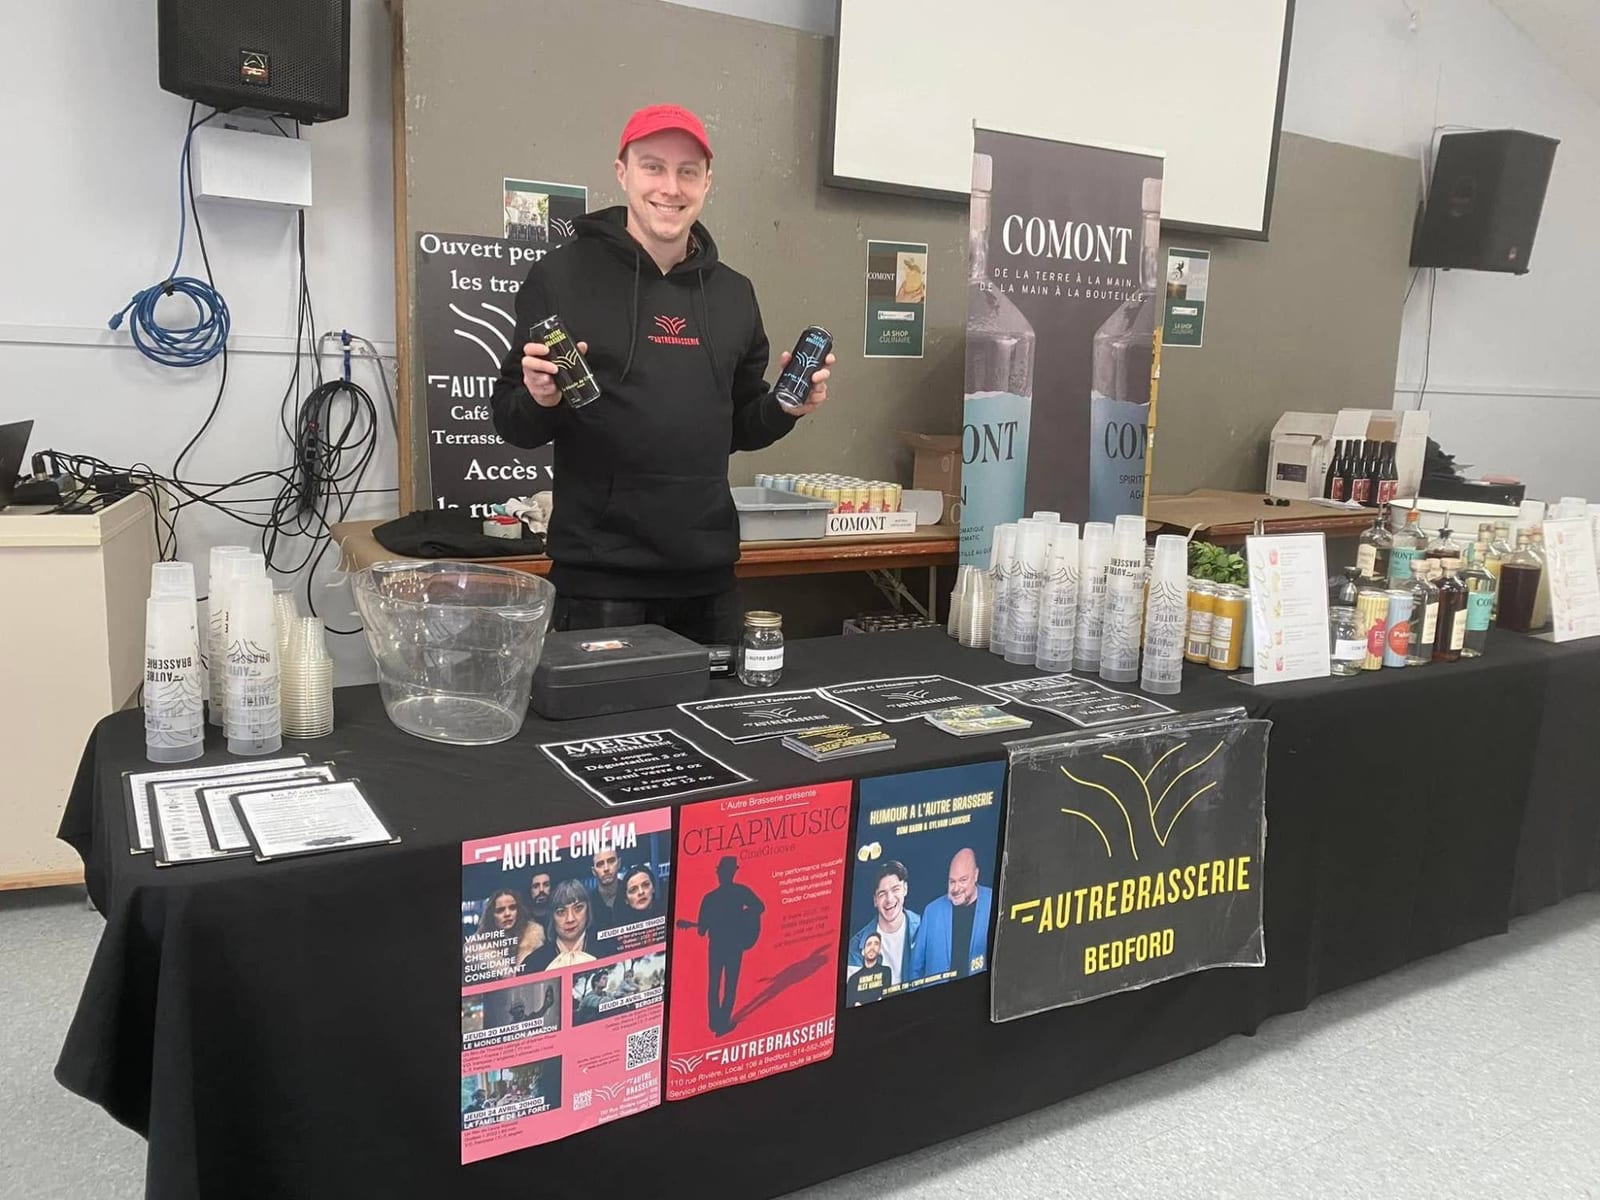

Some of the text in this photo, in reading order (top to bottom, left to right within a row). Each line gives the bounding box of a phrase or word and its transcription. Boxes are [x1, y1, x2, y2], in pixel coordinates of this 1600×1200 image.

[420, 234, 503, 259] Ouvert
[1002, 214, 1133, 265] COMONT
[450, 269, 524, 293] les tra
[867, 271, 896, 281] COMONT
[994, 267, 1009, 278] DE
[1015, 269, 1030, 279] LA
[1036, 271, 1071, 283] TERRE
[1088, 275, 1101, 285] LA
[979, 282, 993, 292] DE
[1000, 283, 1015, 293] LA
[1022, 285, 1049, 296] MAIN
[1068, 289, 1080, 298] LA
[450, 405, 490, 421] Café
[431, 430, 505, 445] Terrasse
[464, 458, 538, 481] Accès
[830, 515, 887, 532] COMONT
[147, 657, 192, 670] BRASSERIE
[696, 700, 757, 711] Collaboration
[564, 733, 664, 755] MENU
[584, 755, 660, 772] Dégustation
[603, 773, 640, 782] Demi
[642, 767, 674, 777] verre
[620, 784, 659, 793] Verre
[662, 780, 677, 788] de
[680, 776, 696, 784] 12
[720, 789, 817, 811] L'Autre Brasserie présente
[870, 806, 908, 826] HUMOUR
[918, 798, 951, 818] L'AUTRE
[952, 791, 994, 812] BRASSERIE
[683, 805, 849, 856] CHAPMUSIC
[502, 820, 638, 872] AUTRE CINÉMA
[1038, 856, 1252, 934] AUTREBRASSERIE
[464, 929, 506, 943] VAMPIRE
[600, 929, 620, 938] JEUDI
[626, 922, 645, 932] MARS
[465, 936, 519, 954] HUMANISTE
[1084, 928, 1175, 976] BEDFORD
[464, 947, 510, 963] CHERCHE
[464, 956, 517, 973] SUICIDAIRE
[464, 963, 527, 983] CONSENTANT
[600, 1001, 619, 1011] JEUDI
[464, 1042, 472, 1050] LE
[474, 1037, 502, 1049] MONDE
[527, 1024, 558, 1039] AMAZON
[465, 1018, 543, 1041] JEUDI 20 MARS 19H30
[721, 1016, 835, 1065] AUTREBRASSERIE
[669, 1086, 696, 1098] Service
[708, 1076, 739, 1090] boissons
[465, 1111, 487, 1121] JEUDI
[498, 1105, 517, 1114] AVRIL
[519, 1099, 543, 1109] 20H00
[518, 1110, 527, 1118] LA
